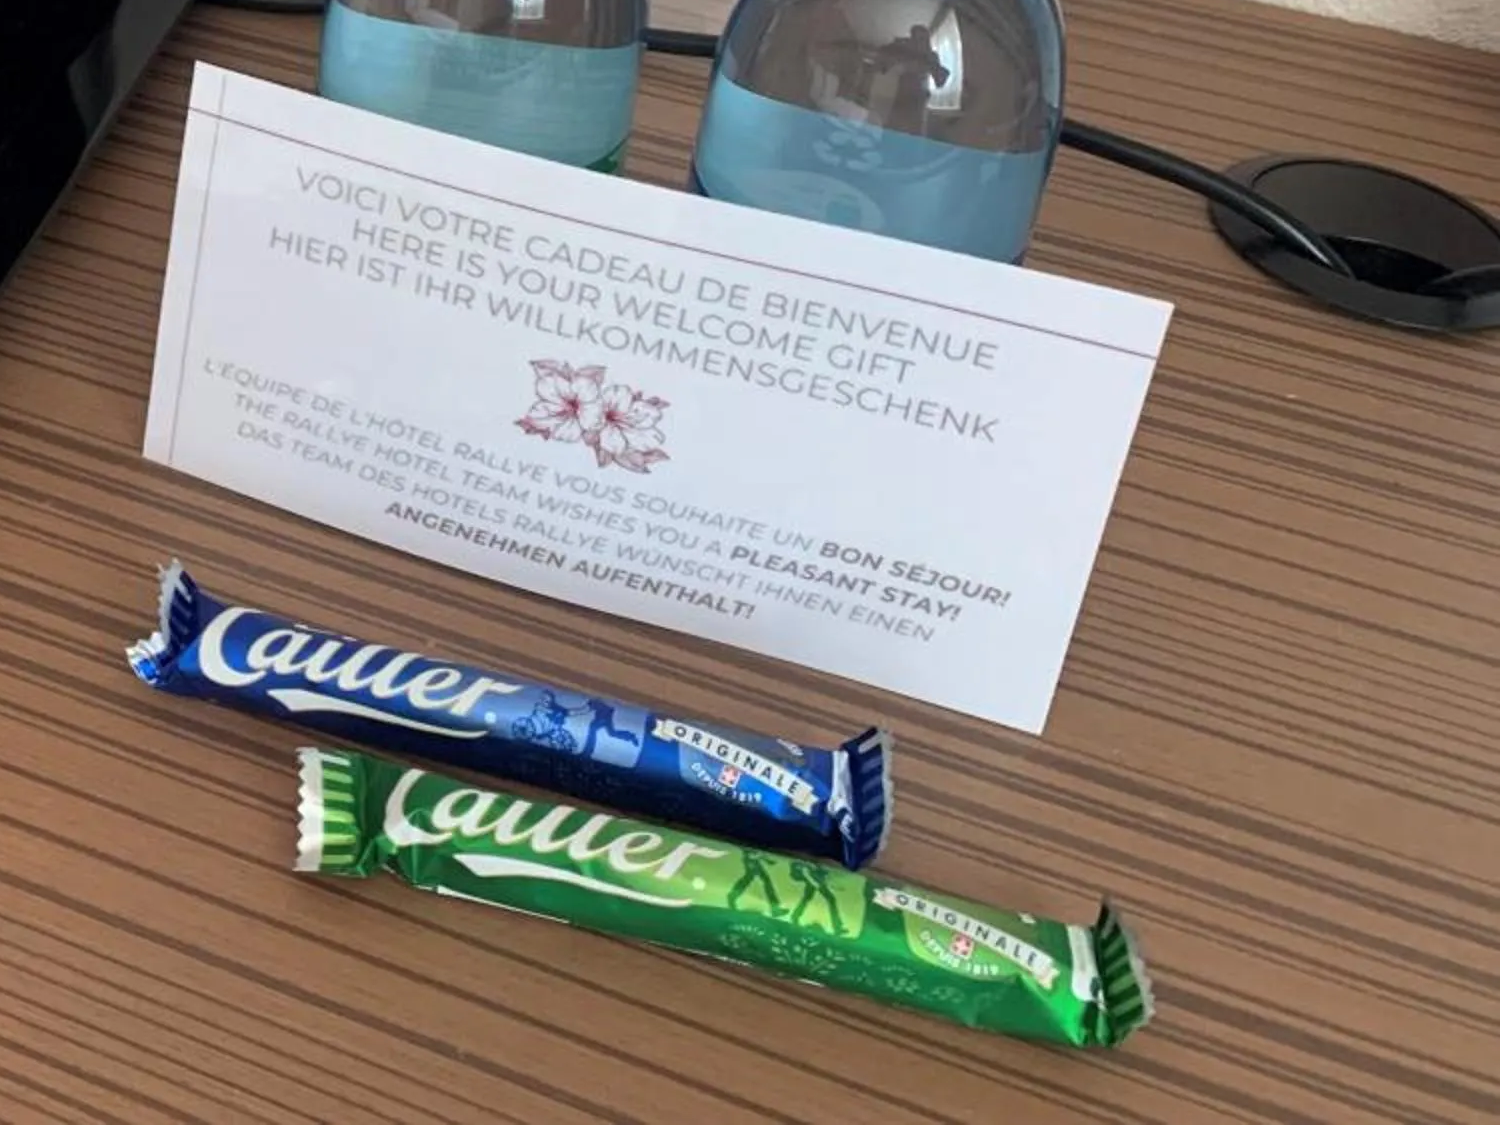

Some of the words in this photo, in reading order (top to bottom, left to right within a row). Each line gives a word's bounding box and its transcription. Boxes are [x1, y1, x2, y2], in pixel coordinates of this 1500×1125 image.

[269, 227, 348, 270] HIER
[358, 254, 406, 288] IST
[415, 275, 476, 310] IHR
[486, 291, 1000, 443] WILLKOMMENSGESCHENK
[297, 166, 386, 216] VOICI
[397, 194, 515, 253] VOTRE
[525, 234, 685, 296] CADEAU
[697, 276, 751, 310] DE
[762, 292, 1000, 371] BIENVENUE
[352, 219, 446, 269] HERE
[457, 249, 486, 277] IS
[498, 261, 600, 311] YOUR
[613, 292, 818, 363] WELCOME
[827, 344, 916, 384] GIFT
[235, 392, 274, 422] THE
[283, 411, 366, 452] RALLYE
[375, 441, 453, 482] HOTEL
[462, 469, 531, 505] TEAM
[537, 495, 636, 535] WISHES
[646, 523, 699, 550] YOU
[704, 539, 722, 557] A
[729, 544, 877, 597] PLEASANT
[880, 586, 962, 623] STAY!
[236, 421, 283, 451] DAS
[291, 440, 353, 474] TEAM
[359, 463, 407, 493] DES
[411, 481, 512, 527] HOTELS
[513, 515, 608, 555] RALLYE
[616, 541, 751, 595] WÜNSCHT
[755, 579, 845, 617] IHNEN
[849, 605, 936, 643] EINEN
[311, 394, 345, 420] DE
[454, 441, 548, 484] RALLYE
[554, 470, 626, 505] VOUS
[633, 492, 768, 542] SOUHAITE
[774, 527, 816, 553] UN
[820, 539, 884, 572] BON
[889, 558, 1012, 608] SÉJOUR!
[385, 500, 568, 570] ANGENEHMEN
[571, 557, 756, 621] AUFENTHALT!
[199, 606, 525, 717] Cailler
[383, 768, 730, 877] Cailler
[672, 725, 799, 794] ORIGINALE
[895, 893, 1038, 967] ORIGINALE
